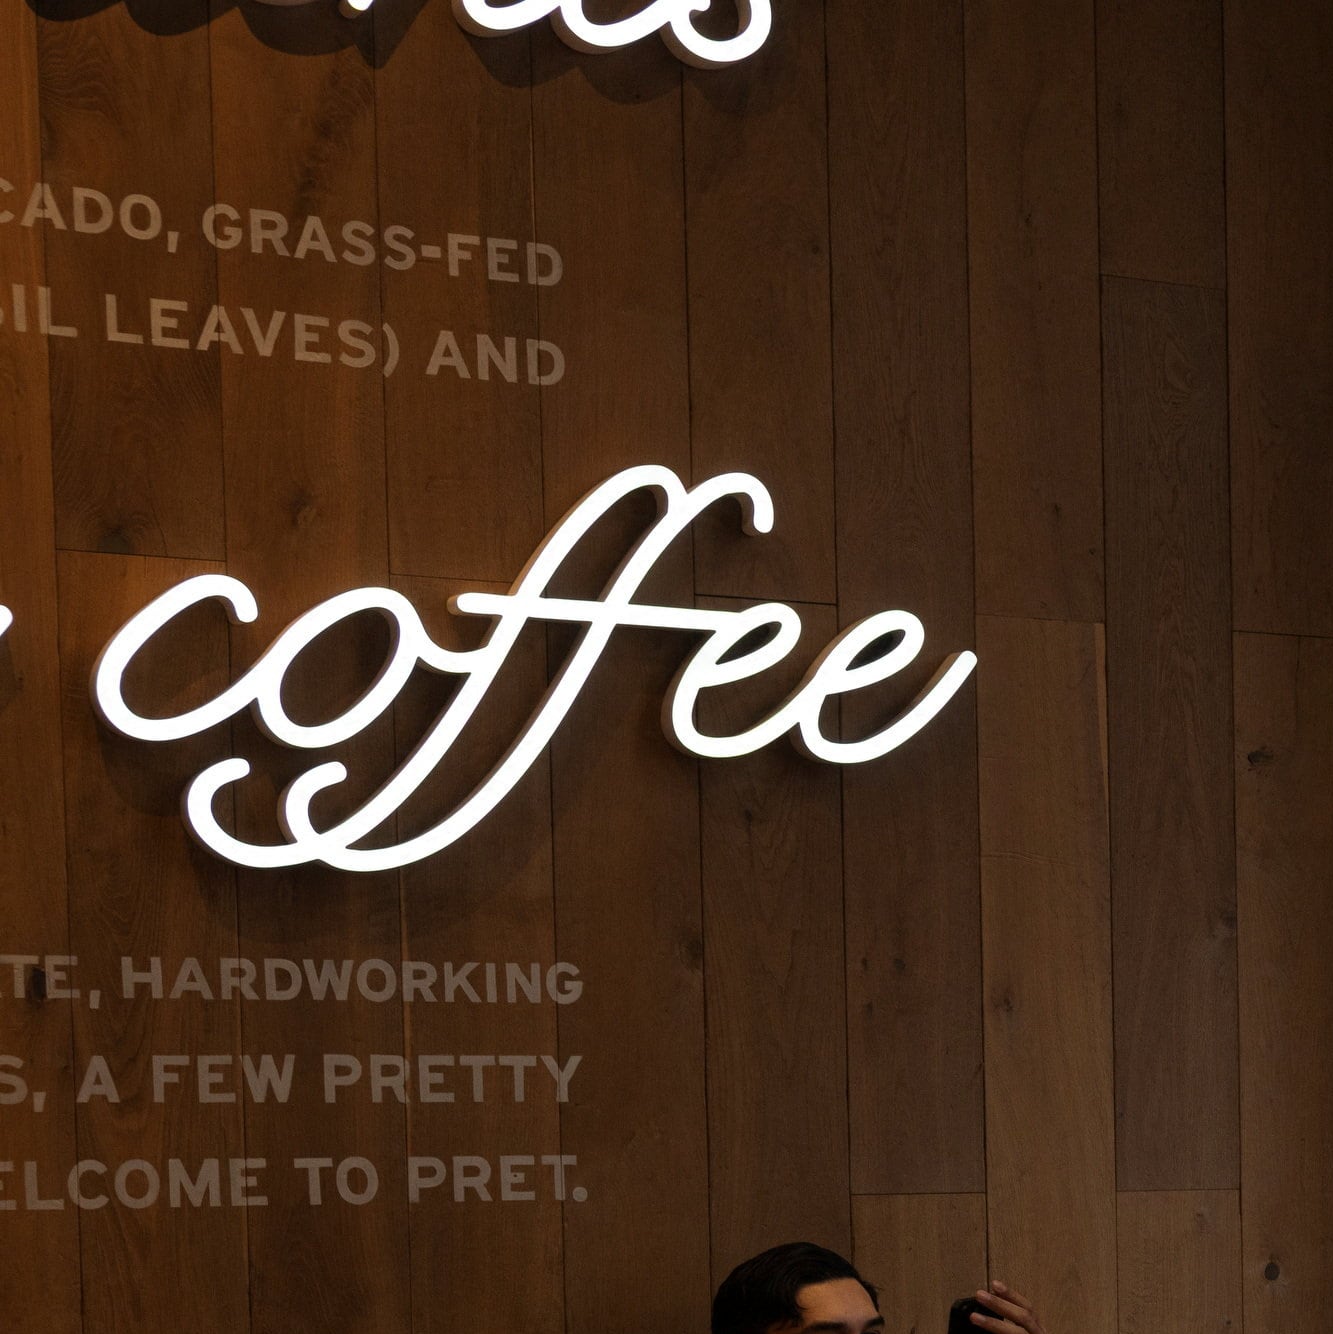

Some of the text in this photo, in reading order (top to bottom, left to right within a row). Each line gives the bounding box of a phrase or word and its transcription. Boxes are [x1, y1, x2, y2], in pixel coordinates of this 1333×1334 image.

[202, 203, 564, 287] GRASS-FED
[0, 283, 566, 387] IL LEAVES) AND
[95, 464, 978, 873] coffee
[120, 955, 585, 1006] HARDWORKING
[76, 1054, 121, 1104] A
[152, 1053, 297, 1104] FEW
[322, 1054, 585, 1105] PRETTY
[294, 1155, 380, 1207] TO
[407, 1154, 590, 1205] PRET.
